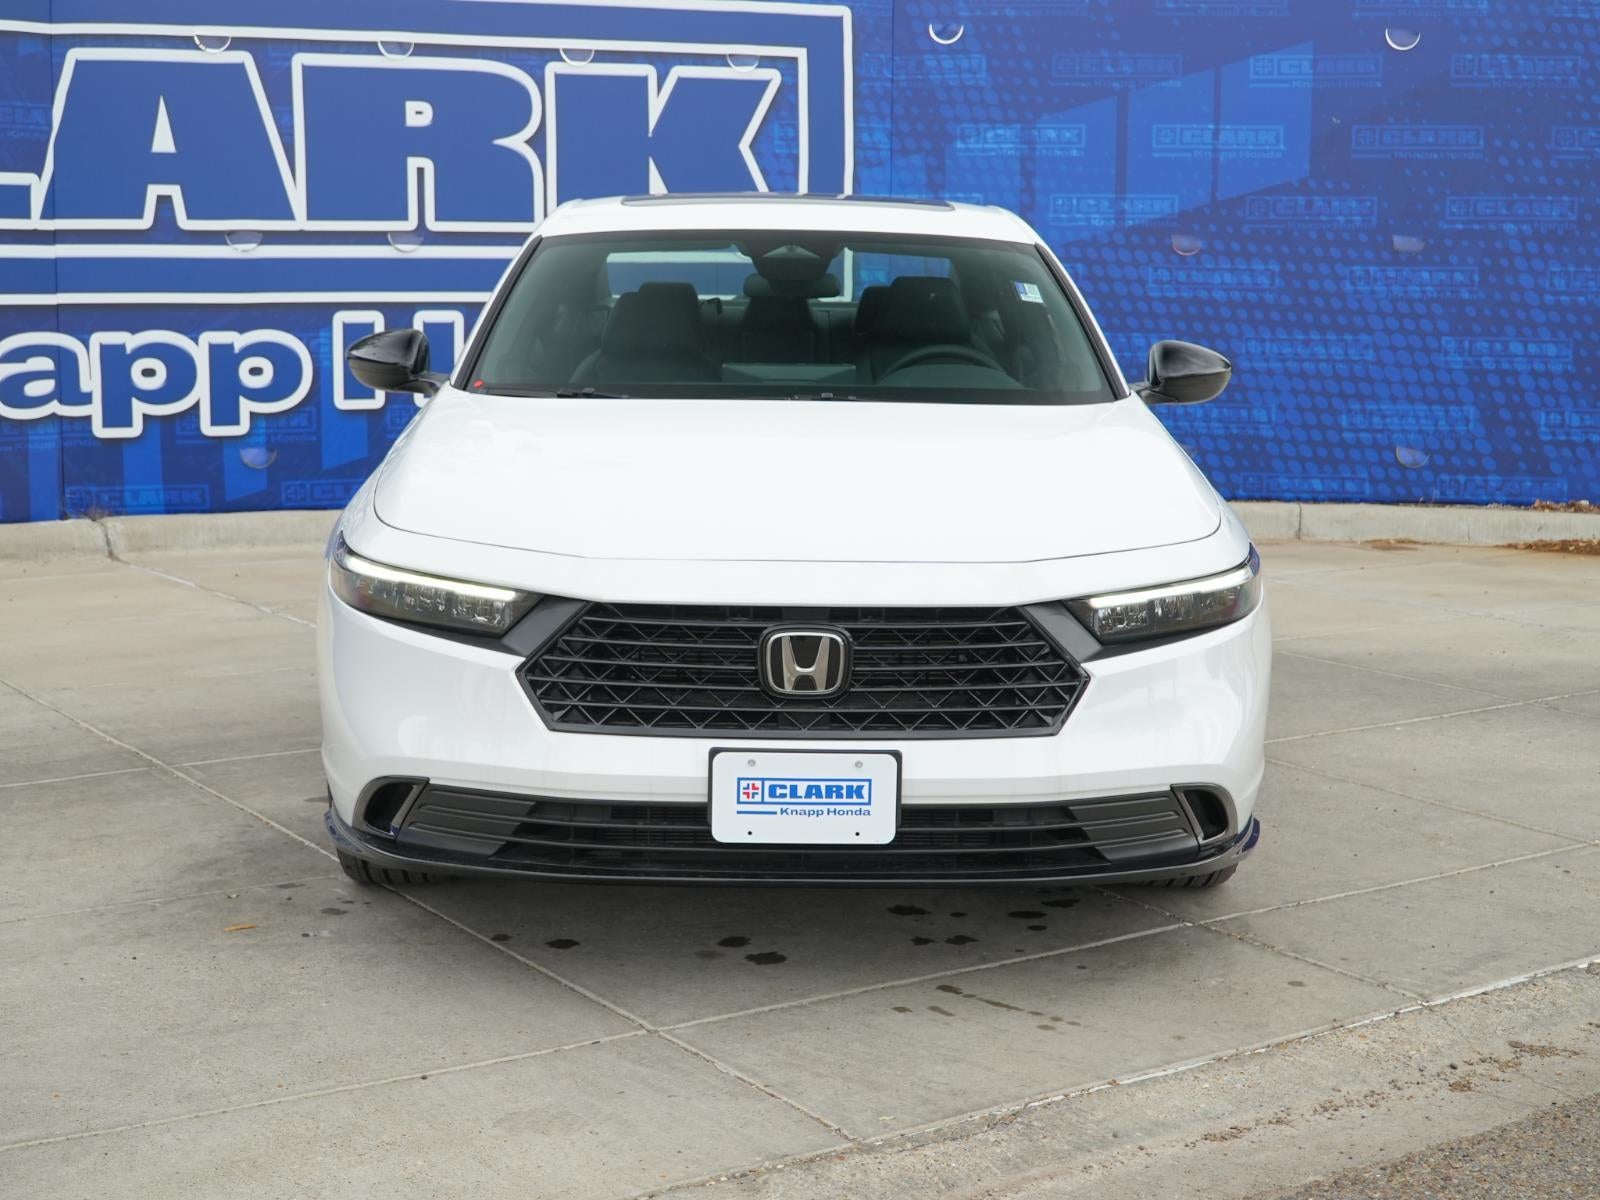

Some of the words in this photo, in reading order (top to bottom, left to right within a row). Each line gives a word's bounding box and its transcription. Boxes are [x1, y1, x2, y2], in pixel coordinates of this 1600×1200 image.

[1182, 129, 1277, 144] CLARK
[768, 784, 866, 799] CLARK
[780, 807, 824, 817] Knapp
[826, 808, 871, 816] Honda
